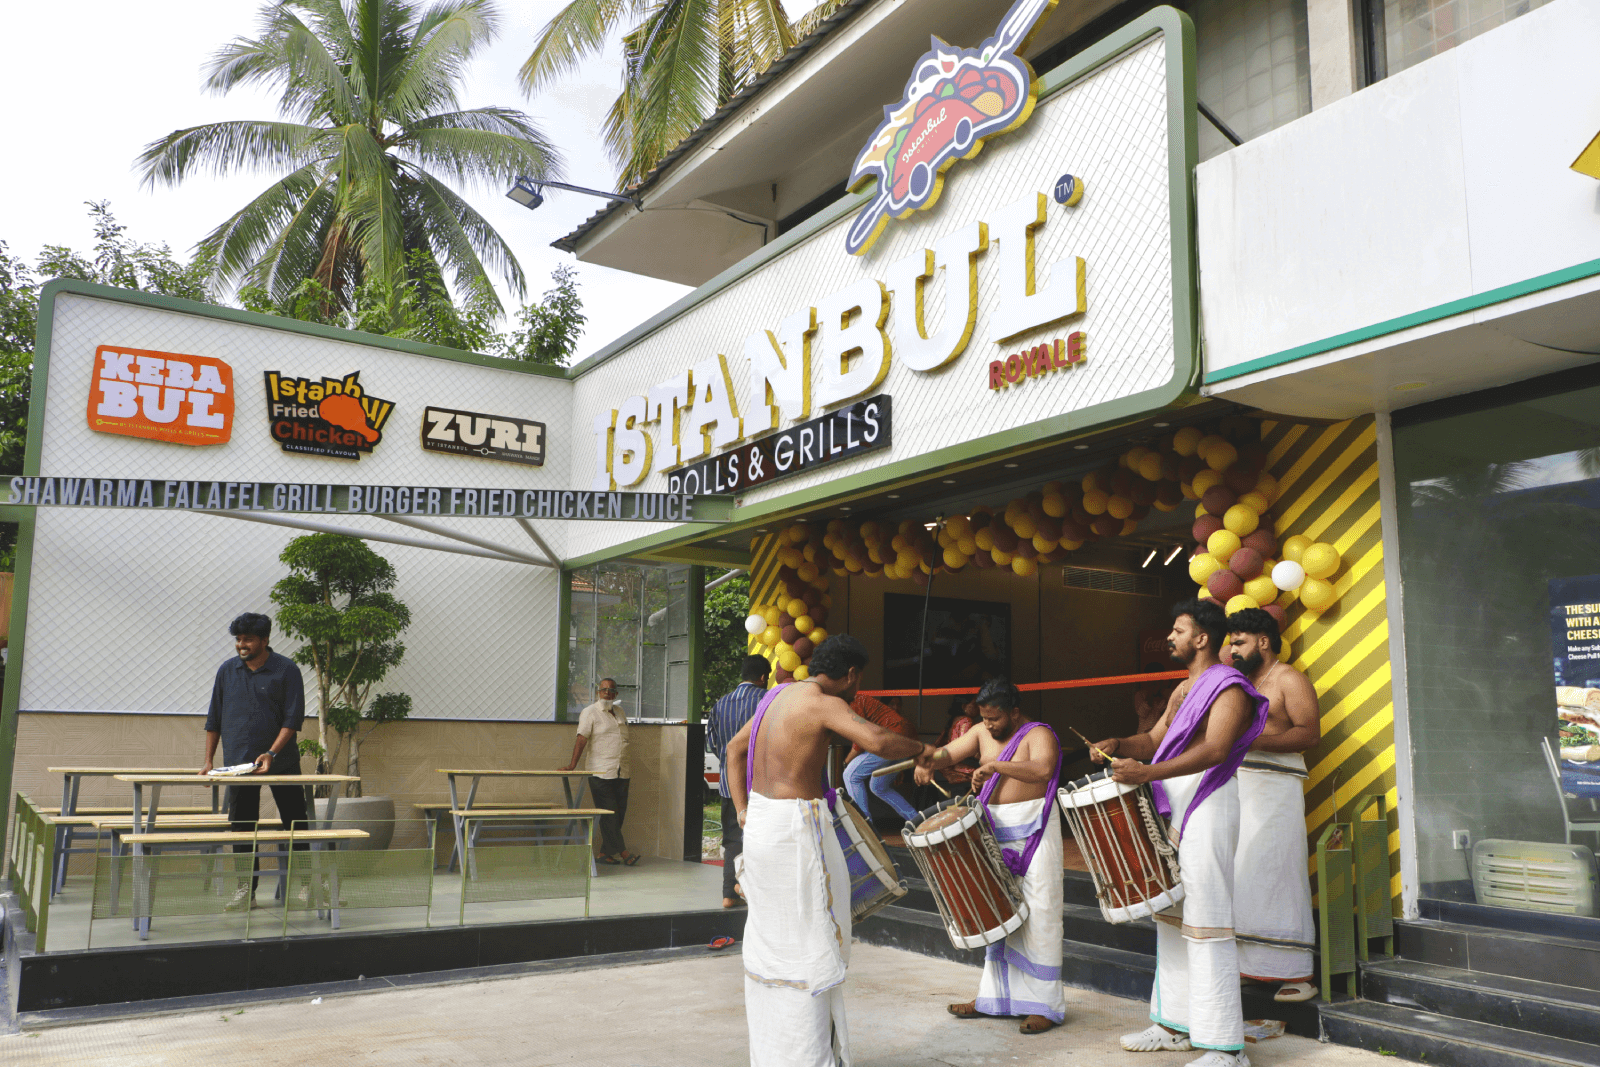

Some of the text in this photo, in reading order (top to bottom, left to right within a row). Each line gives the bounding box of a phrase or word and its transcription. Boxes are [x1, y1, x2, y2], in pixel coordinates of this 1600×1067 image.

[901, 107, 947, 163] Istanbul
[1056, 179, 1074, 199] TM
[593, 190, 1086, 491] ISTANBUL
[989, 331, 1085, 390] ROYALE
[100, 350, 226, 394] KEBA
[97, 379, 225, 430] BUL
[269, 374, 391, 430] Istanbul
[273, 403, 319, 418] Fried
[286, 444, 357, 457] CLASSIFIED FLAVOUR
[427, 410, 541, 454] ZURI
[748, 446, 764, 481] &
[774, 403, 879, 471] GRILLS
[8, 476, 693, 521] SHAWARMA FALAFEL GRILL BURGER FRIED CHICKEN JUICE
[1565, 603, 1600, 615] THE SU
[1565, 617, 1592, 628] WITH
[1567, 629, 1600, 641] CHEES
